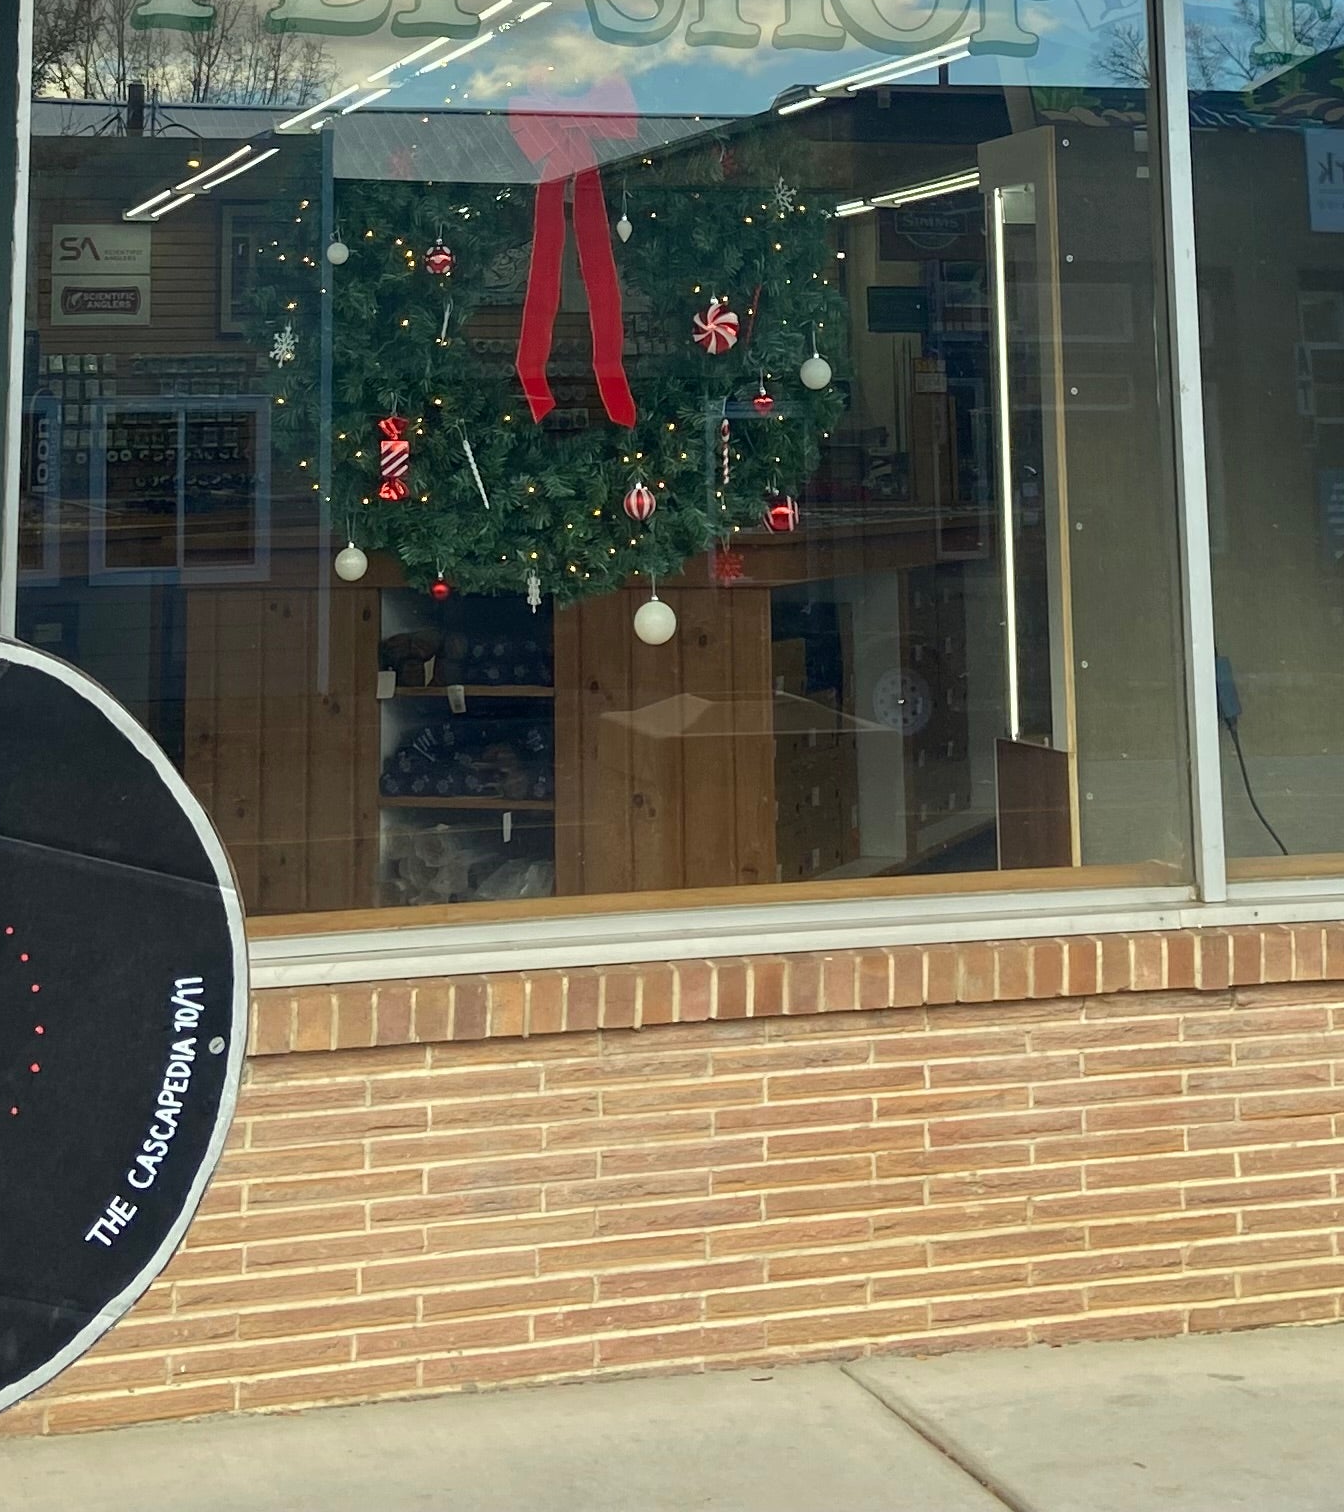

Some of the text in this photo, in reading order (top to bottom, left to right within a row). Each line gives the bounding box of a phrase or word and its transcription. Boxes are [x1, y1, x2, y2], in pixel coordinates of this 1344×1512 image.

[84, 976, 205, 1247] THE CASCAPEDIA 10/11
